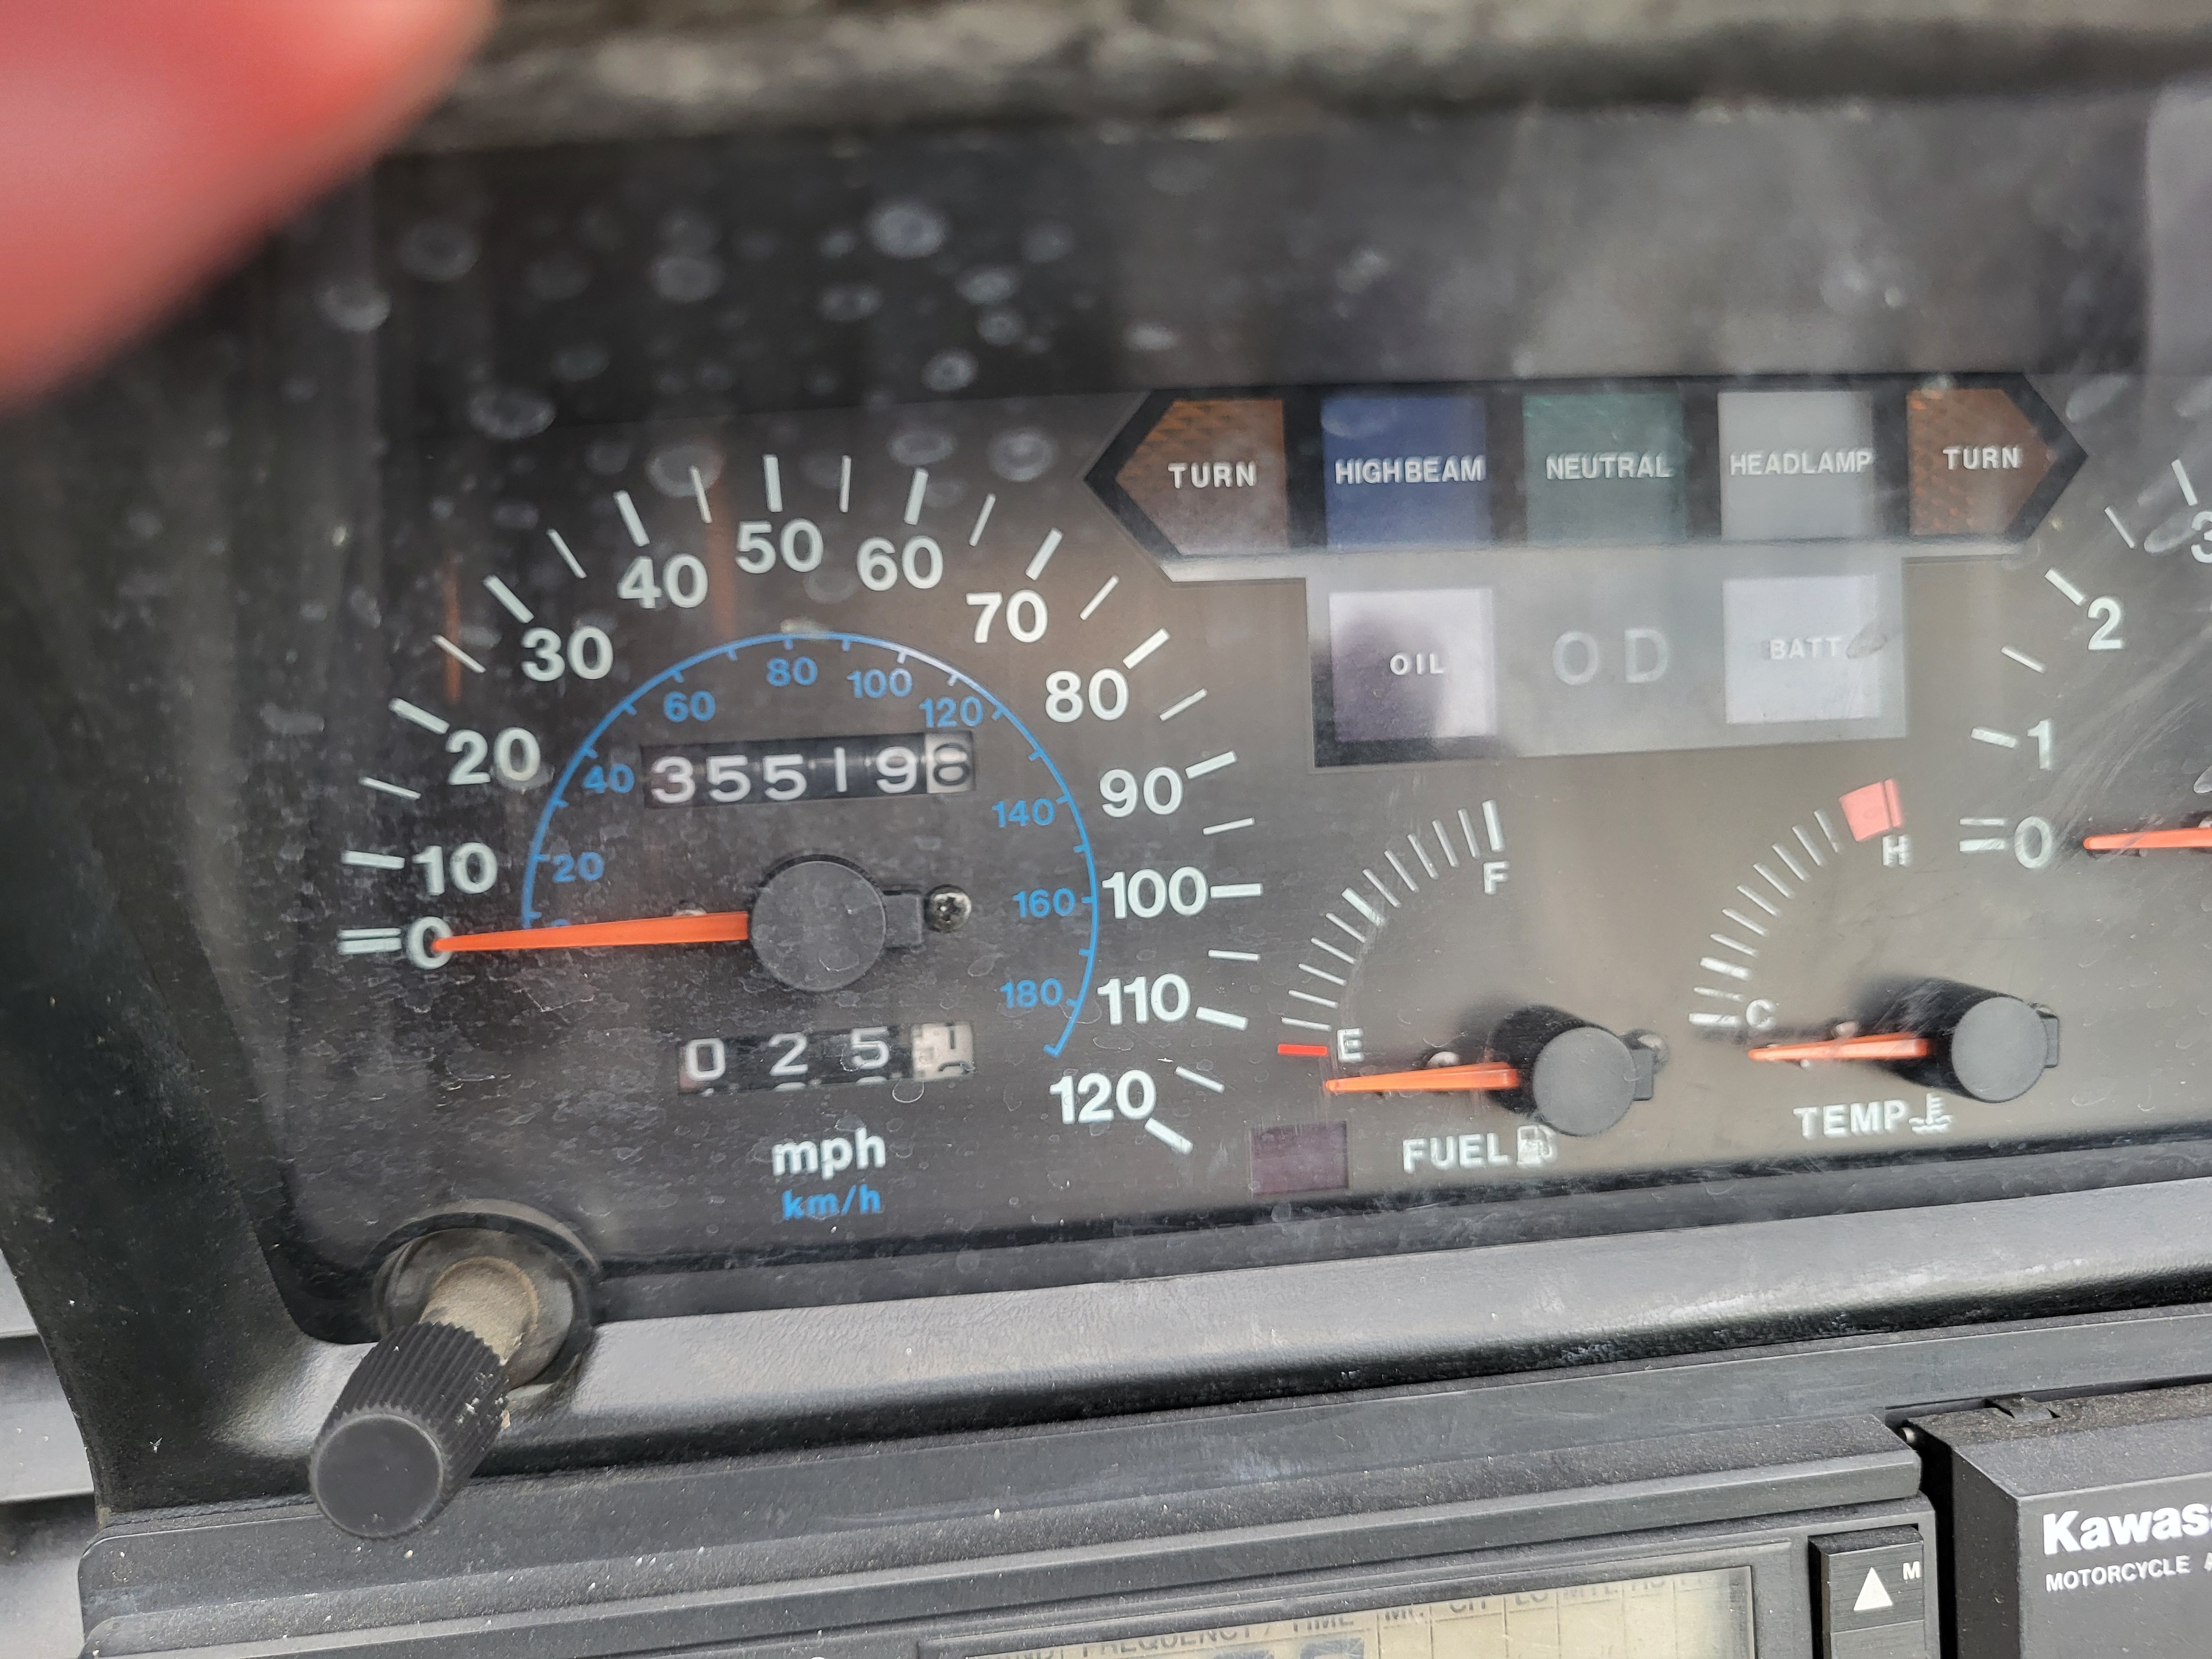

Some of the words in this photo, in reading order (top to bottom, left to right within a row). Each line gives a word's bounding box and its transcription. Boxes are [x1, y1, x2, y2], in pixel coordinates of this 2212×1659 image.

[1167, 461, 1257, 489] TURN
[1335, 455, 1486, 485] HIGHBEAM
[1546, 450, 1675, 480] NEUTRAL
[1729, 447, 1876, 477] HEADLAMP
[1942, 446, 2022, 470] TURN
[736, 518, 824, 574] 50
[856, 535, 944, 591] 60
[618, 554, 708, 609] 40
[966, 588, 1048, 644] 70
[2087, 596, 2126, 651] 2
[521, 626, 613, 681] 30
[1389, 653, 1444, 675] OIL
[1770, 637, 1840, 660] BATT
[766, 656, 818, 687] 80
[848, 667, 913, 699] 100
[664, 691, 715, 722] 60
[919, 696, 983, 728] 120
[1044, 669, 1129, 723] 80
[446, 727, 541, 785] 20
[2026, 719, 2052, 770] 1
[582, 764, 635, 794] 40
[1099, 766, 1183, 818] 90
[992, 797, 1055, 828] 140
[1882, 836, 1911, 867] H
[2014, 816, 2052, 869] 0
[413, 842, 498, 896] 10
[553, 852, 604, 883] 20
[1483, 860, 1510, 895] F
[1013, 888, 1076, 919] 160
[1102, 867, 1208, 920] 100
[406, 916, 453, 969] 0
[1000, 977, 1063, 1009] 180
[1097, 973, 1192, 1026] 110
[1745, 998, 1777, 1030] C
[1336, 1027, 1364, 1063] E
[1050, 1070, 1157, 1125] 120
[1793, 1099, 1908, 1139] TEMP
[773, 1128, 886, 1180] mph
[1402, 1133, 1512, 1173] FUEL
[782, 1185, 881, 1220] km/h
[2042, 1503, 2212, 1555] Kawas
[1902, 1561, 1921, 1580] M
[2046, 1554, 2191, 1592] MOTORCYCLE
